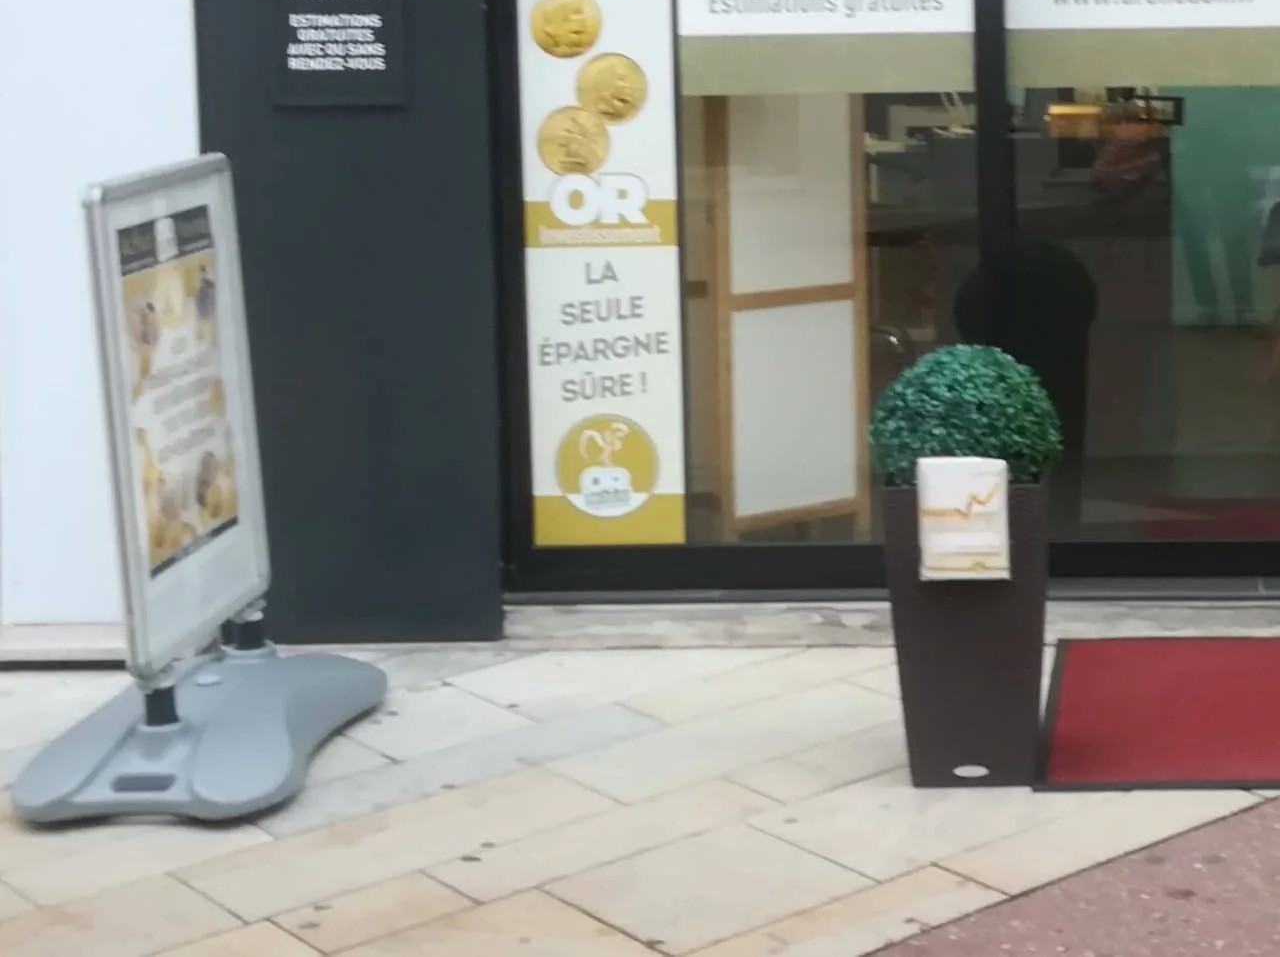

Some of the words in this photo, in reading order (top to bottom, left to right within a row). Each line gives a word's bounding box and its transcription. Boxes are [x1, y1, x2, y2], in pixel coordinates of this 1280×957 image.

[550, 173, 651, 226] OR
[584, 260, 620, 285] LA
[560, 295, 645, 326] SEULE
[538, 331, 670, 367] ÉPARGNE
[560, 370, 635, 403] SÛRE
